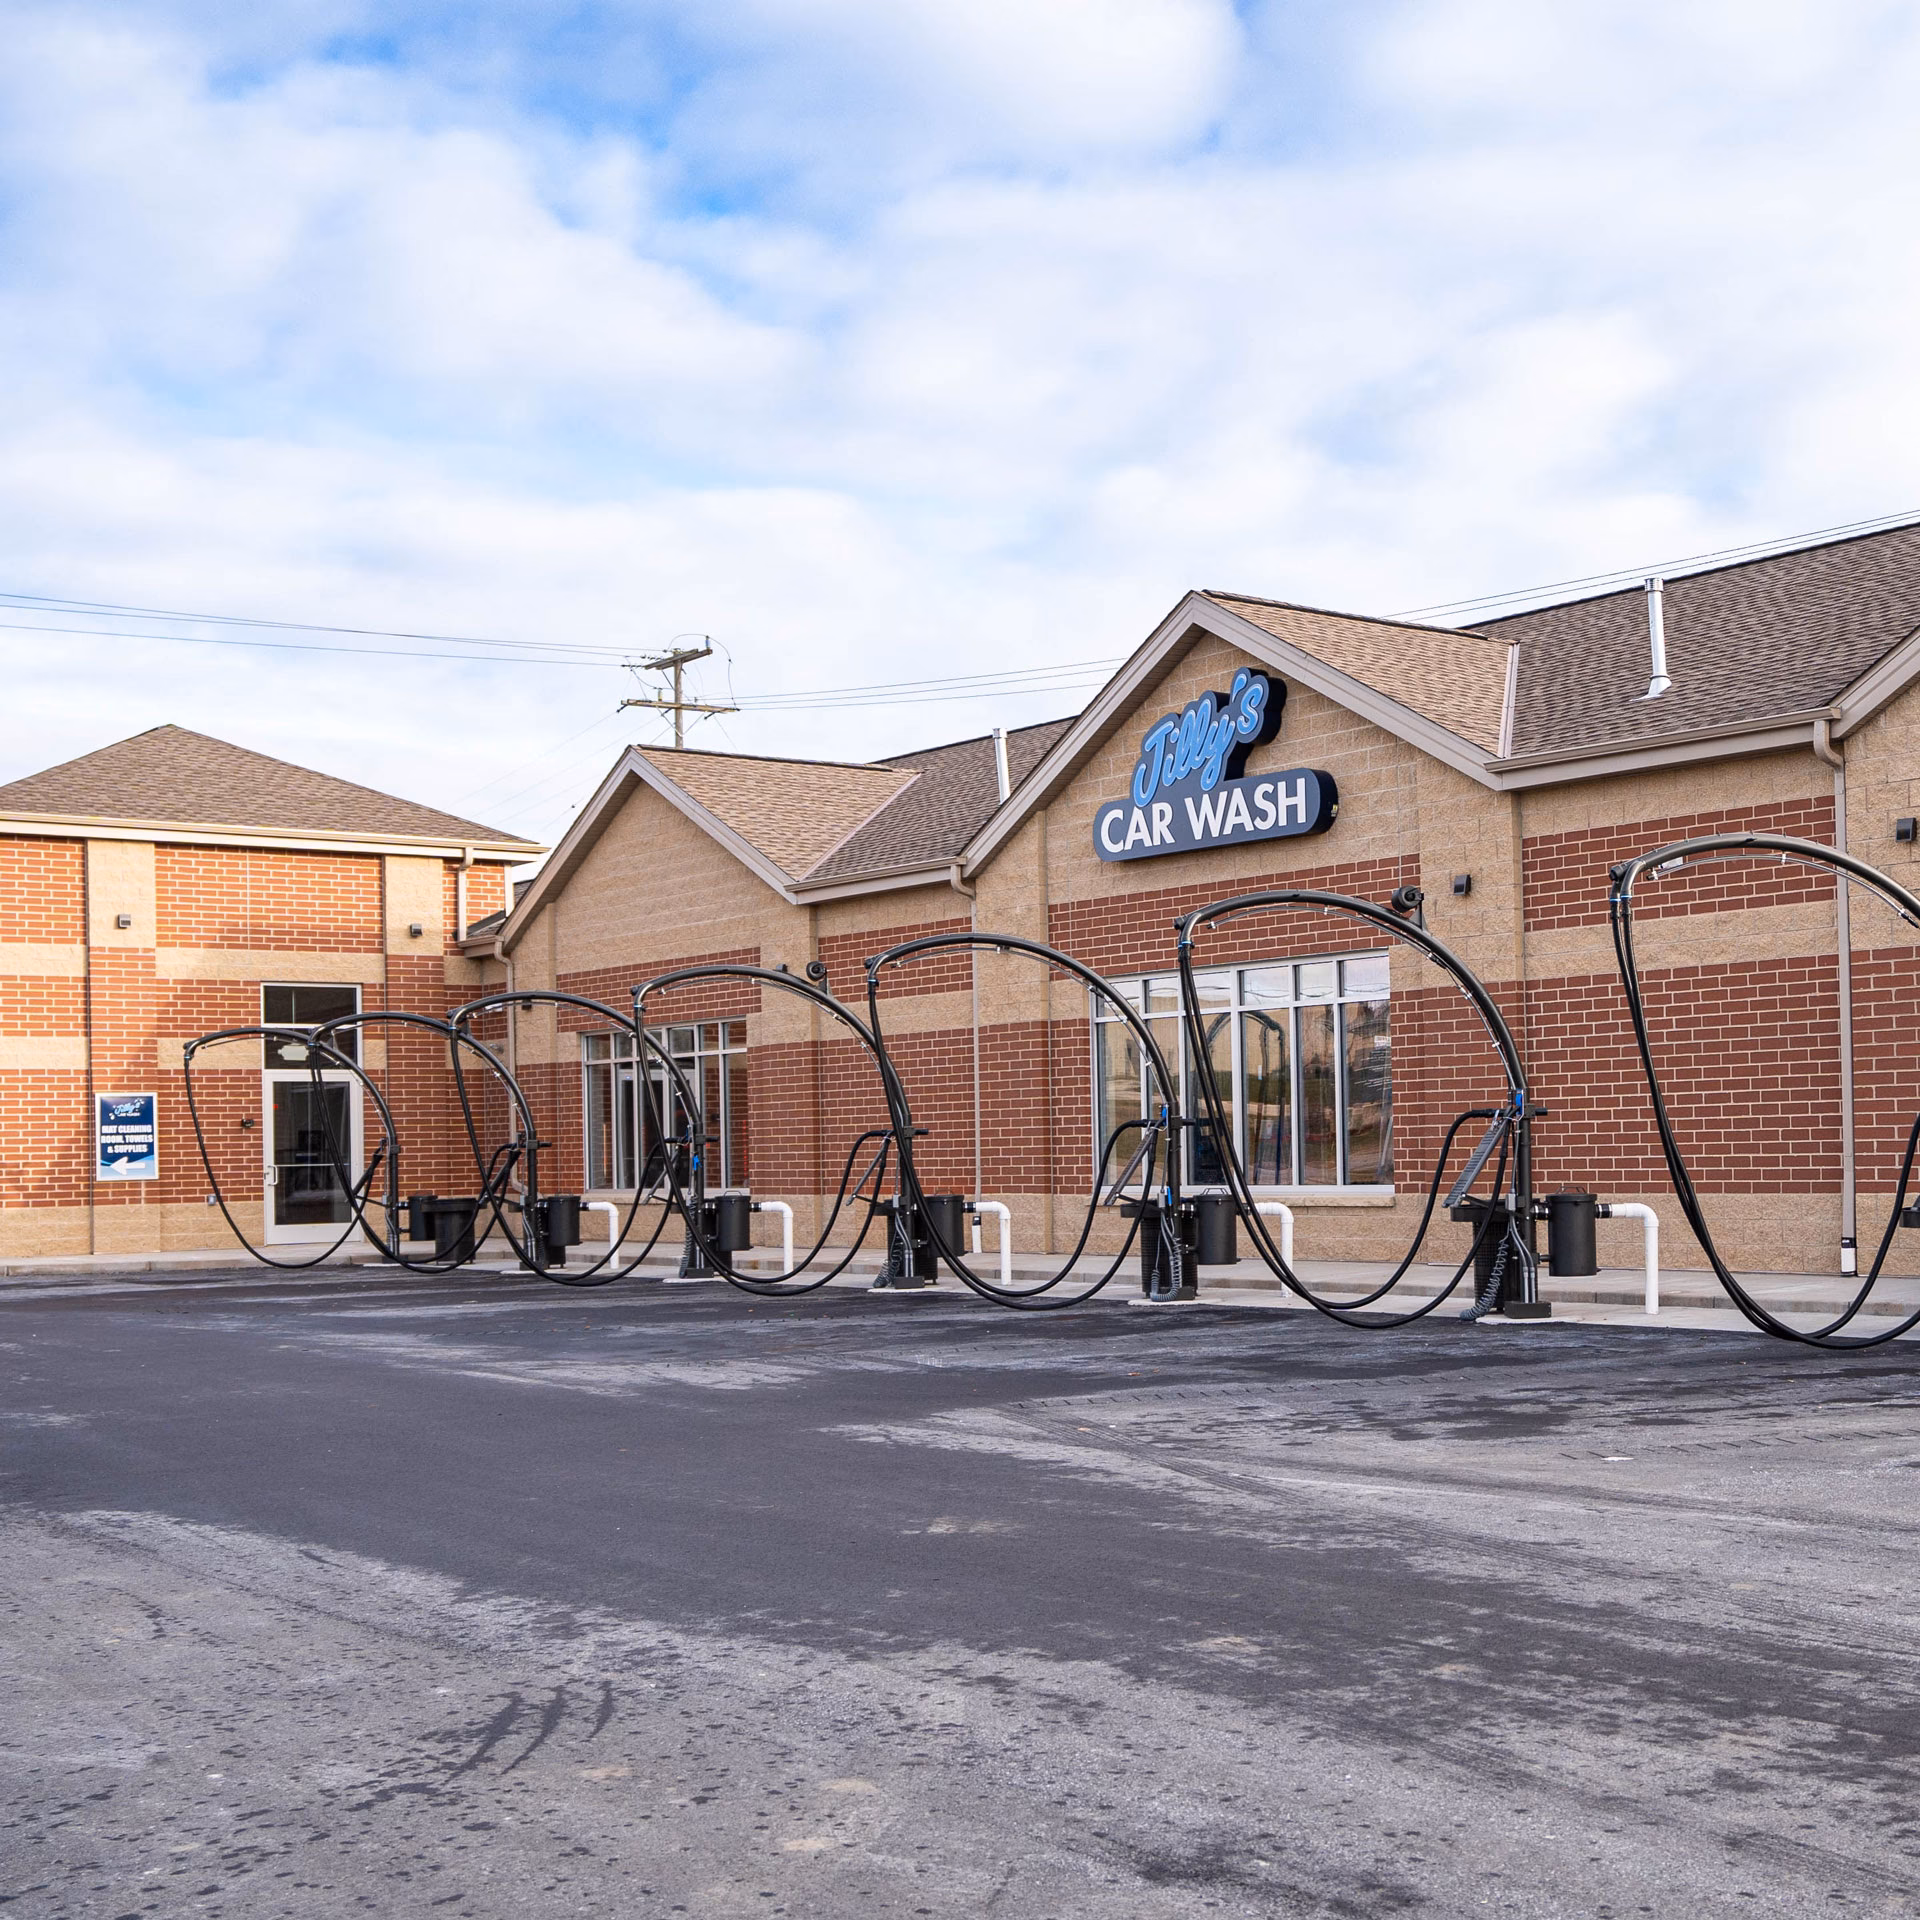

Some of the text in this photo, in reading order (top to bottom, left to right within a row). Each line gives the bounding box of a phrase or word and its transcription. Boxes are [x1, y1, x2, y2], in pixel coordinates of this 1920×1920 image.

[1133, 673, 1264, 807] Jilly's
[1100, 777, 1307, 853] CAR WASH
[118, 1124, 152, 1134] CLEANING
[125, 1134, 153, 1143] TOWELS
[107, 1144, 148, 1154] & SUPPLIES
